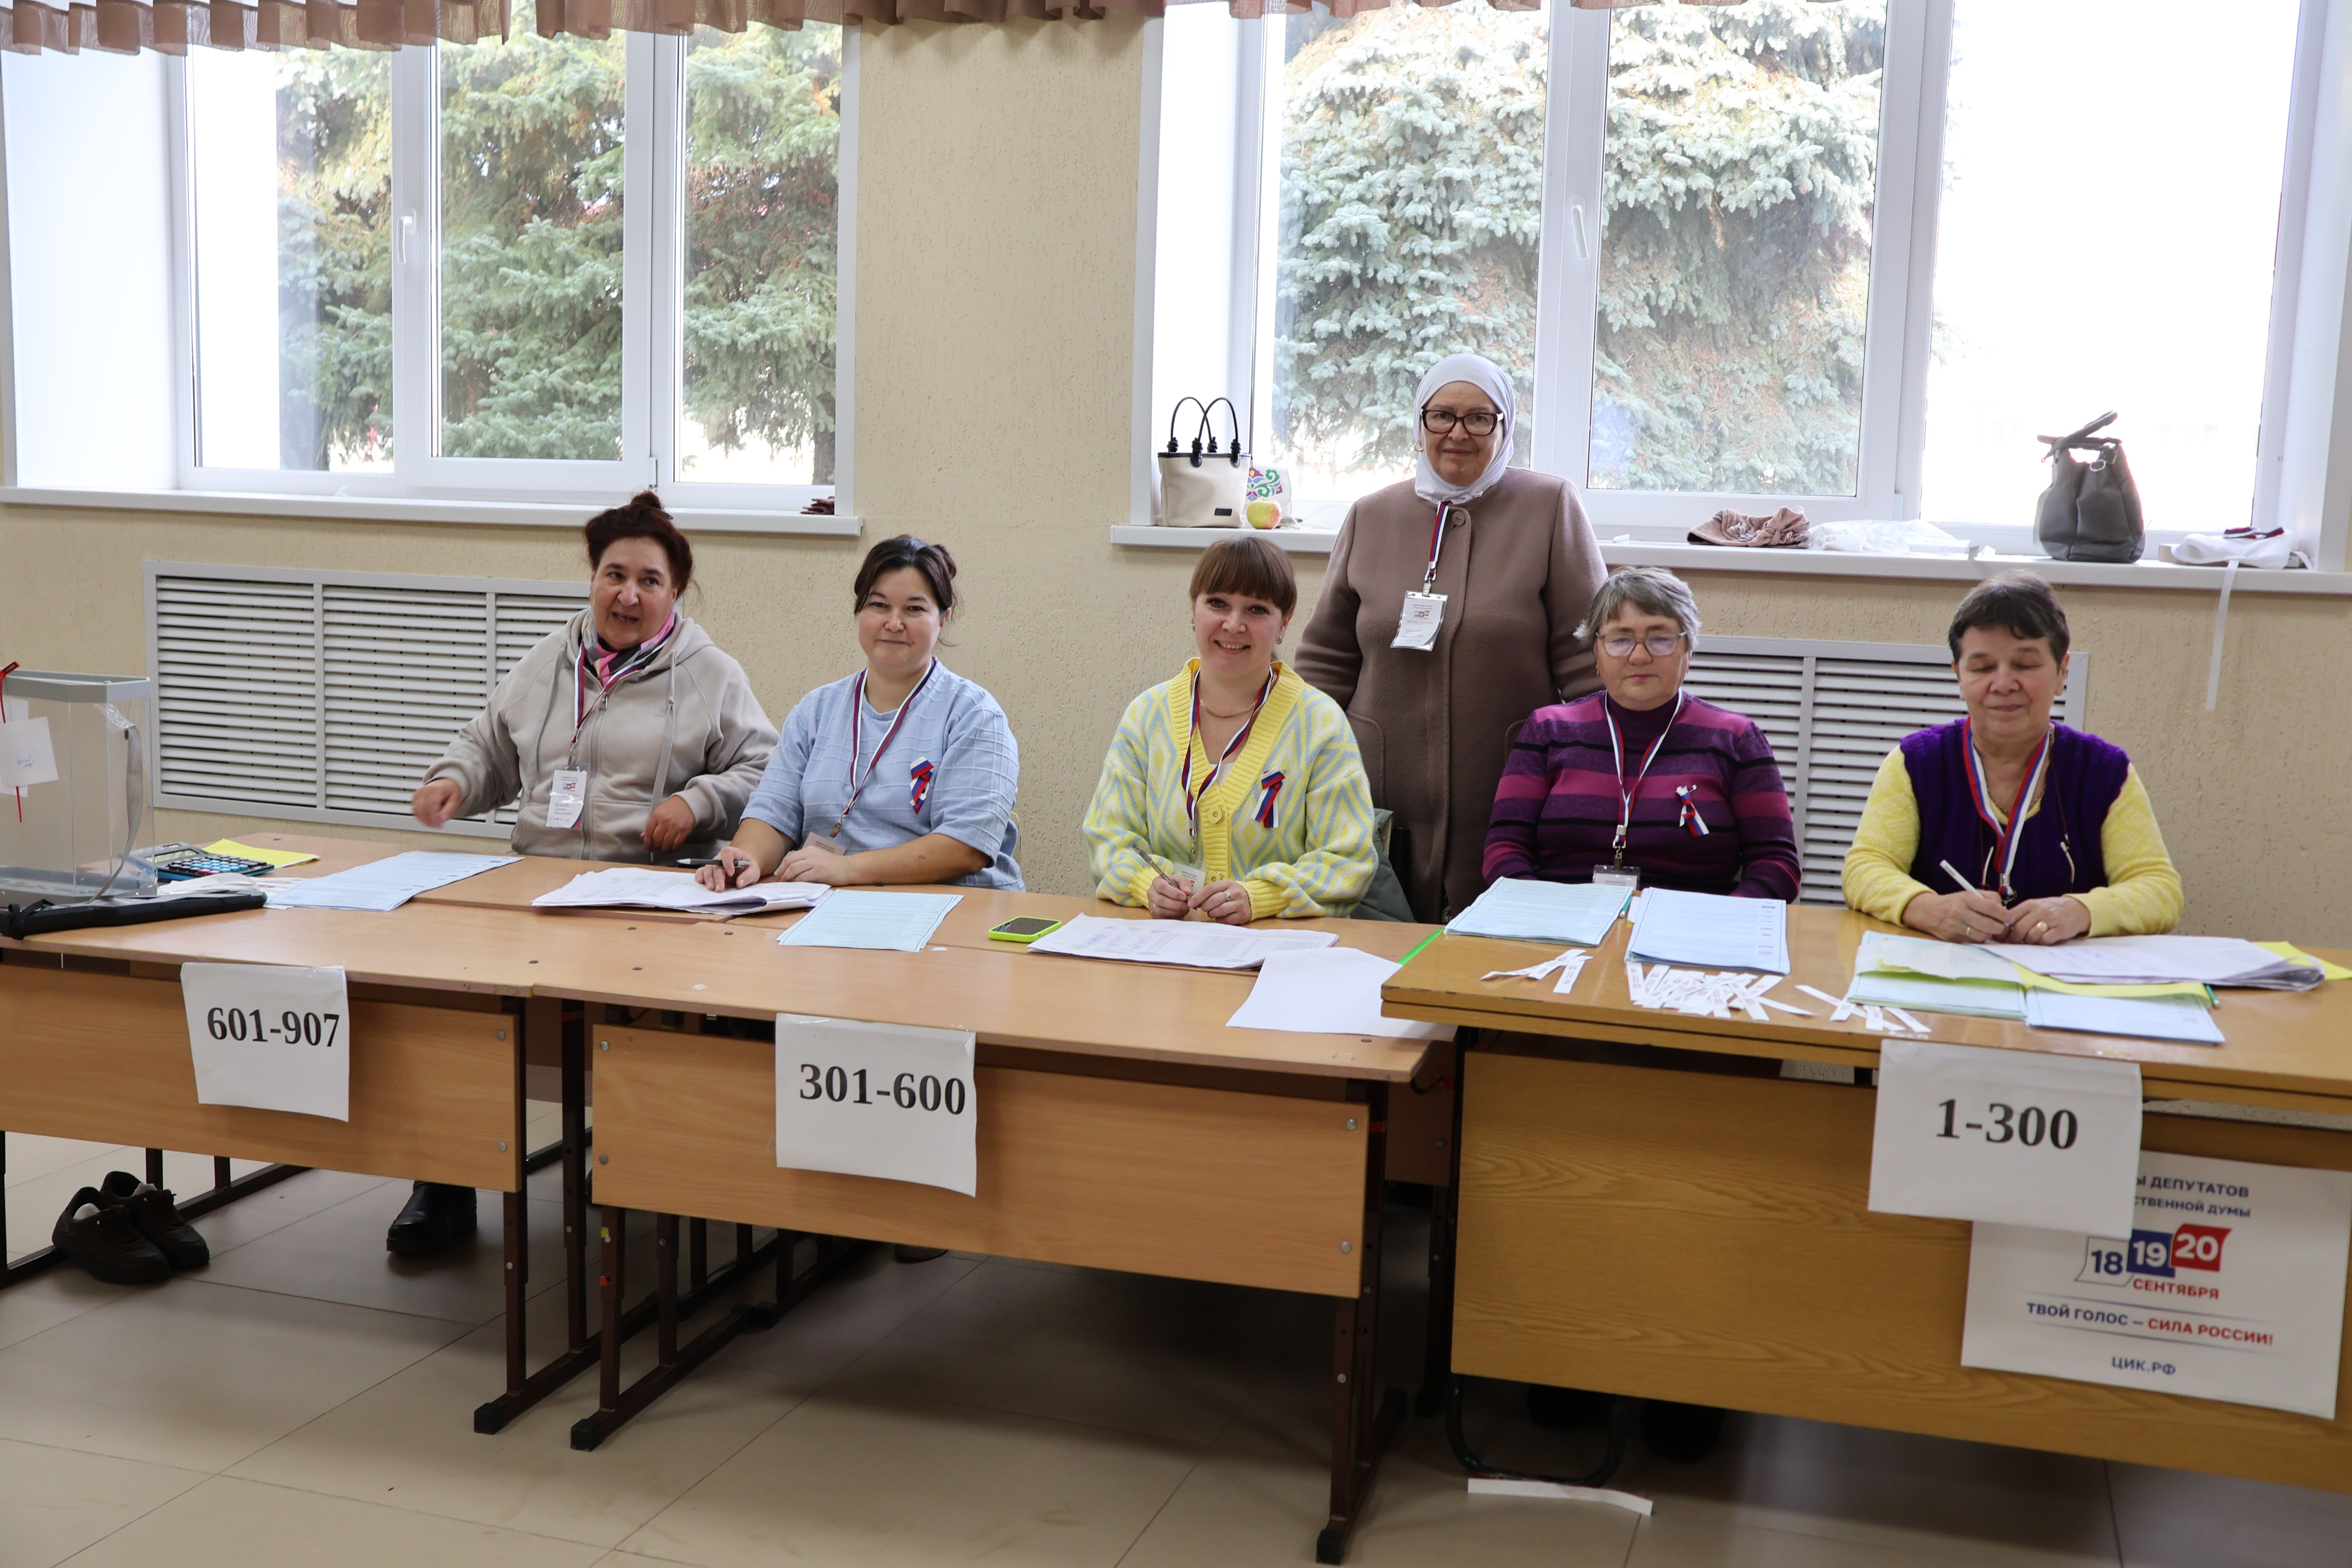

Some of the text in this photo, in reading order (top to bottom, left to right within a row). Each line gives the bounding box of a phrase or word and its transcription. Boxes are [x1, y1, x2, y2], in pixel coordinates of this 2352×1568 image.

[207, 1007, 340, 1047] 601-907
[799, 1063, 966, 1115] 301-600
[1936, 1098, 2078, 1150] 1-300
[2150, 1176, 2249, 1198] ДЕПУТАТОВ
[2208, 1203, 2251, 1218] ДУМЫ
[2091, 1233, 2219, 1276] 18 19 20
[2133, 1278, 2220, 1300] СЕНТЯБРЯ
[2027, 1302, 2070, 1318] ТВОЙ
[2074, 1309, 2128, 1326] ГОЛОС
[2148, 1317, 2193, 1334] СИЛА
[2198, 1325, 2274, 1345] РОССИИ!
[2112, 1356, 2176, 1376] ЦИК.РФ
